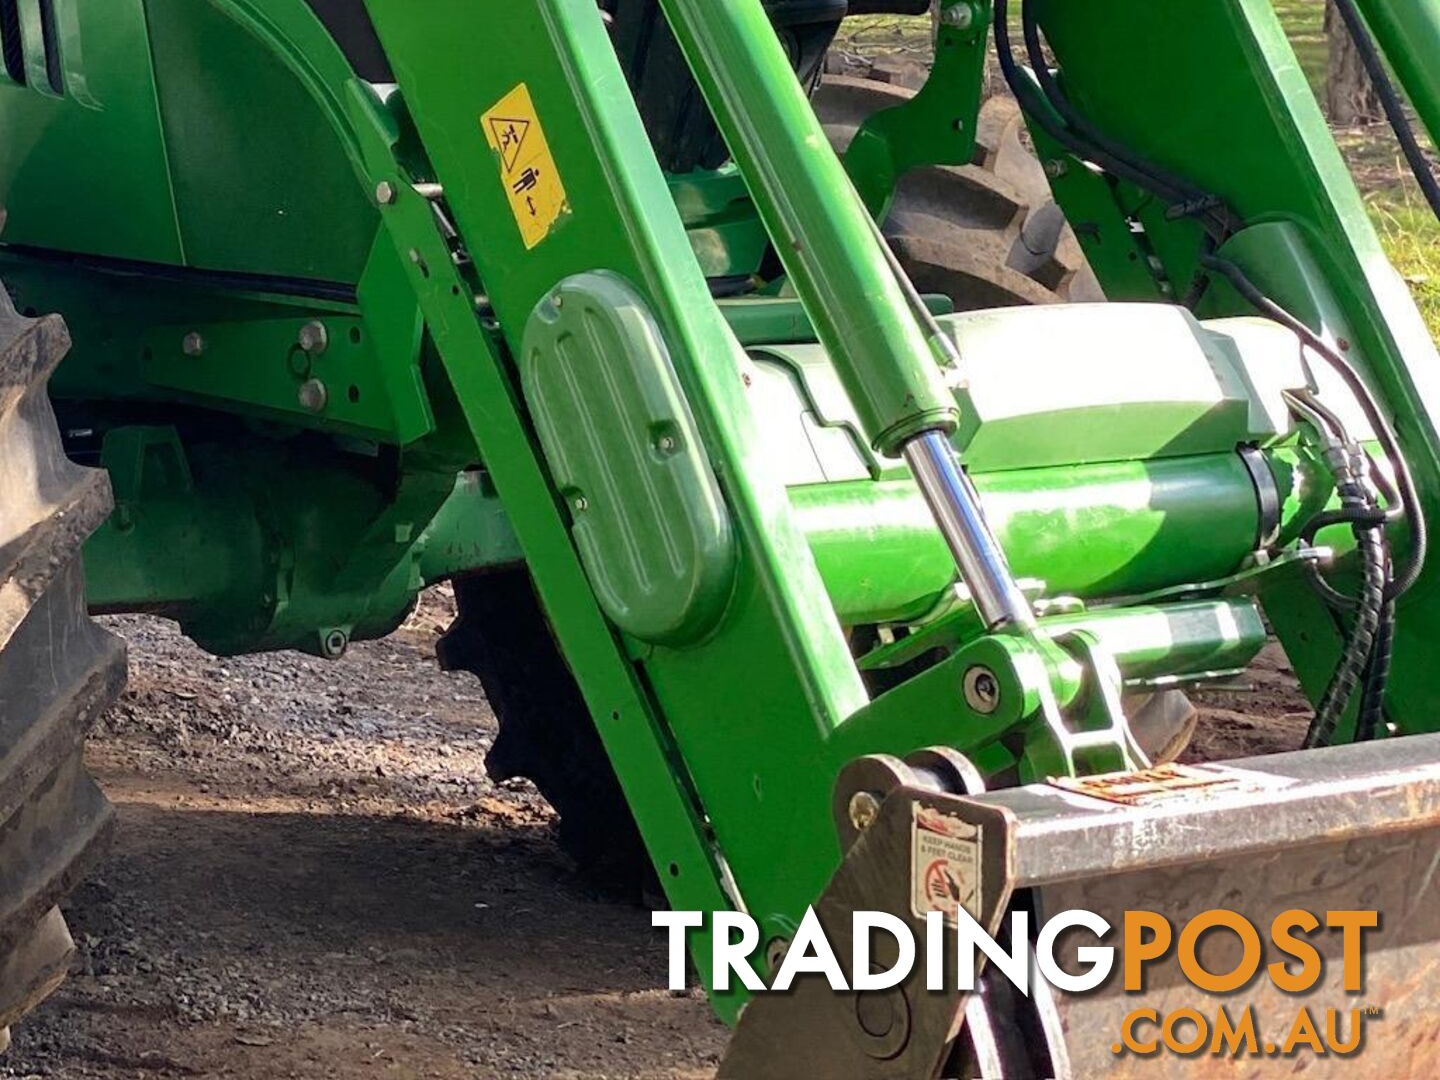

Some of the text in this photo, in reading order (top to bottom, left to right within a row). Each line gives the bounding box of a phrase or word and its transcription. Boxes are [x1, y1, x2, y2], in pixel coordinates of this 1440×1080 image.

[922, 835, 971, 854] KEEP HANDS
[927, 846, 946, 857] FEET
